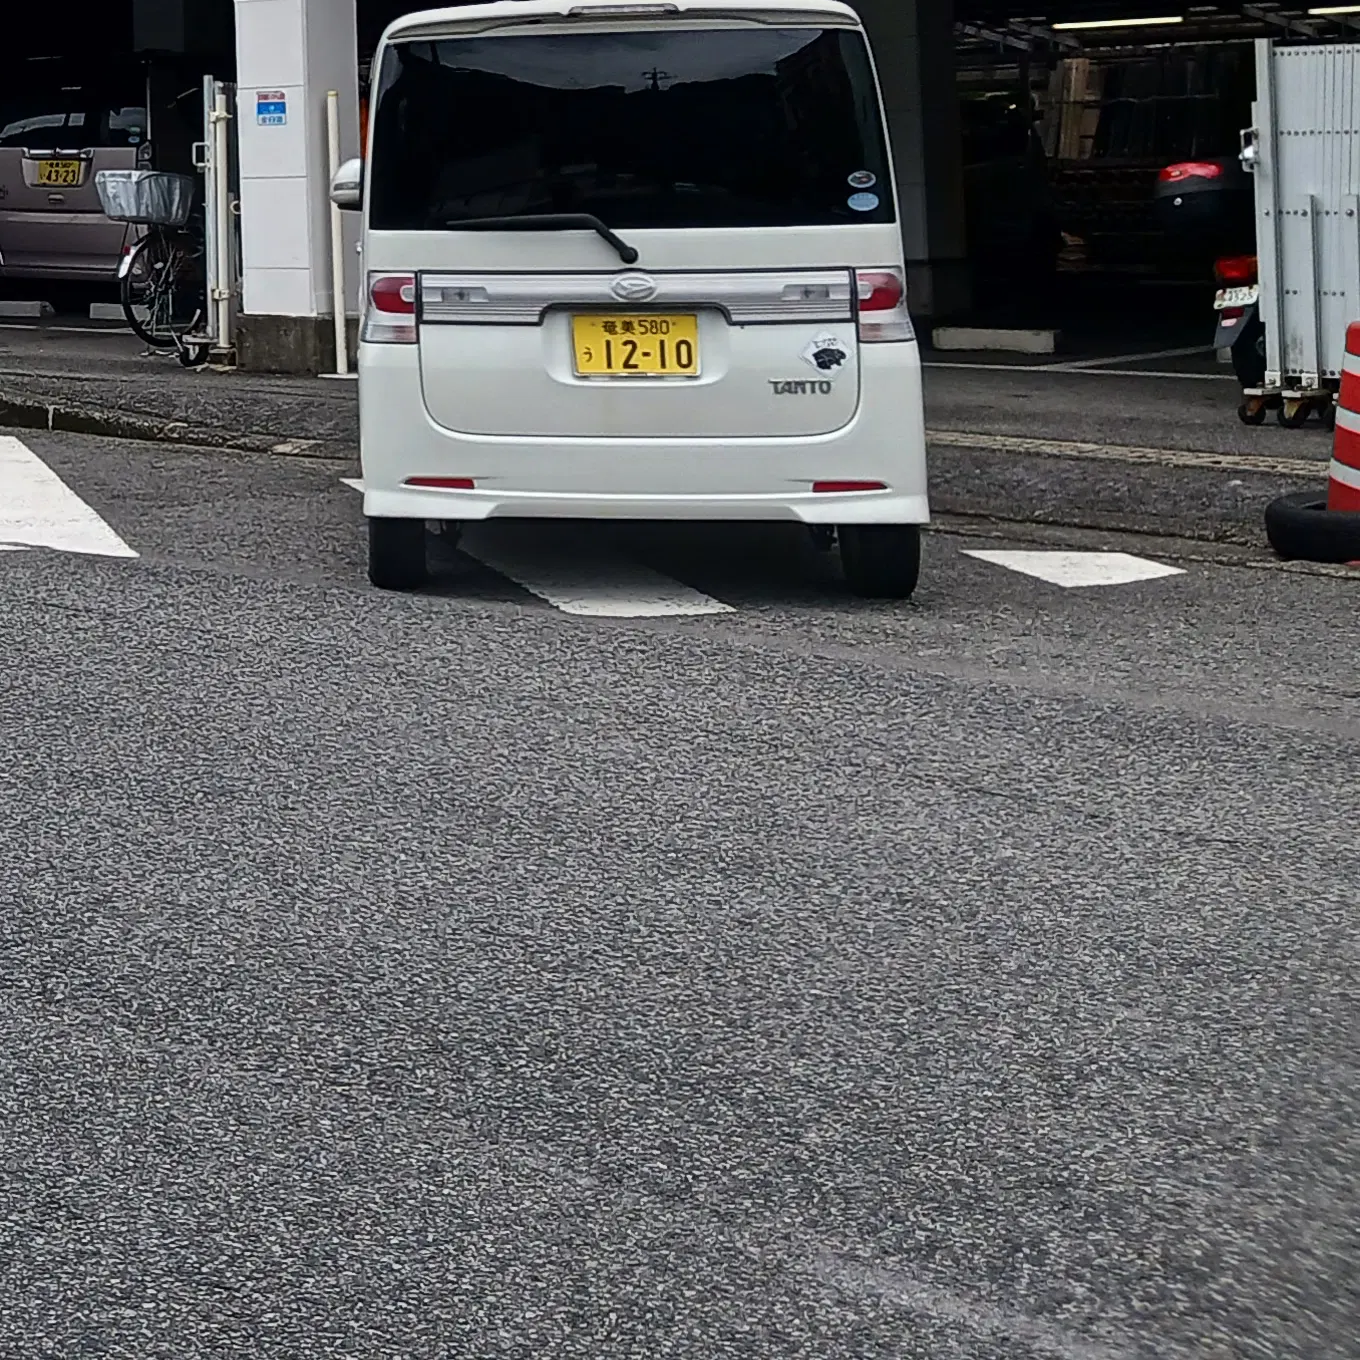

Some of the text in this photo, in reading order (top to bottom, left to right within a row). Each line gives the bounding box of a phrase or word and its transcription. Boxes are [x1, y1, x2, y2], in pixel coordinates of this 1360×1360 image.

[583, 339, 693, 369] う 12-10
[769, 378, 834, 395] TANTO
